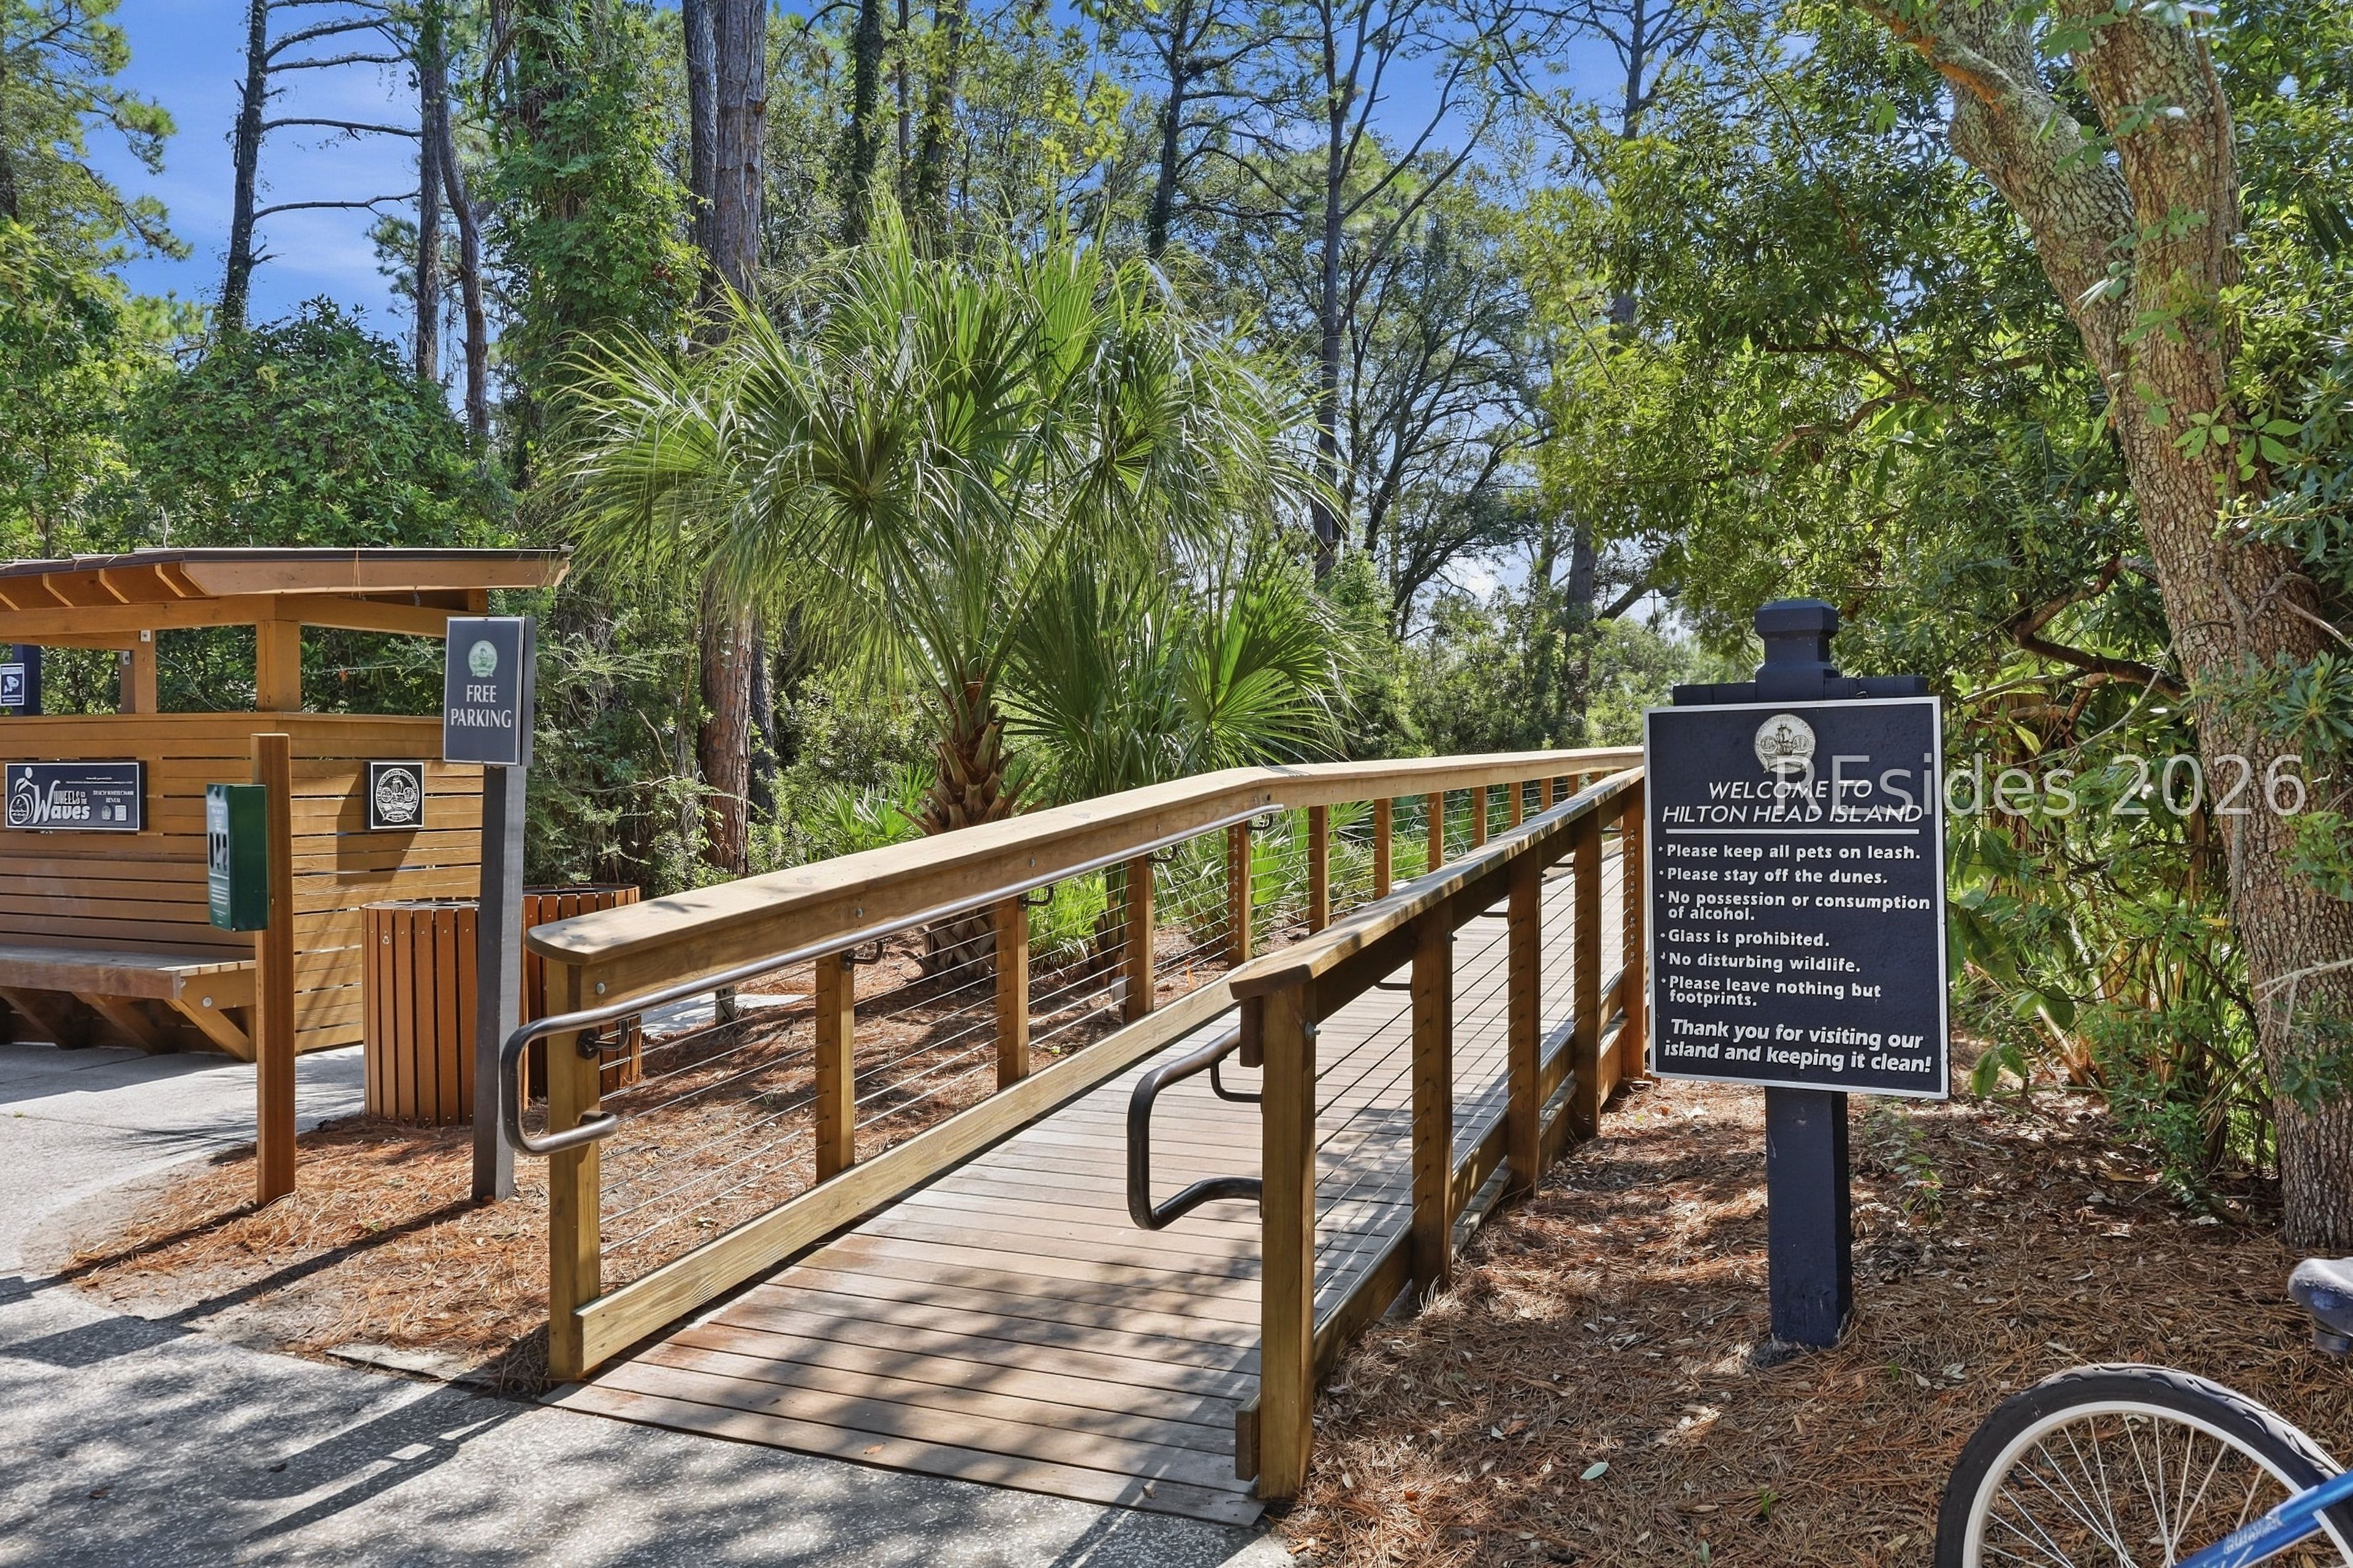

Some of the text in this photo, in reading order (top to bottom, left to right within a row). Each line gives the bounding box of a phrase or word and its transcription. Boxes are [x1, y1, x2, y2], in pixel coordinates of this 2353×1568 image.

[466, 684, 497, 703] FREE
[450, 708, 512, 728] PARKING
[53, 790, 80, 805] WHEELS
[1708, 779, 1873, 800] WELCOME TO
[1662, 804, 1923, 824] HILTON HEAD ISLAND
[1667, 844, 1920, 862] Please keep all pets on leash.
[1667, 867, 1887, 885] Please stay off the dunes.
[1668, 890, 1930, 913] No possession or consumption
[1668, 906, 1755, 920] of alcohol.
[1669, 929, 1830, 948] Glass is prohibited.
[1669, 952, 1860, 973] No disturbing wildlife.
[1669, 975, 1881, 1000] Please leave nothing but
[1670, 990, 1757, 1008] footprints.
[1671, 1018, 1923, 1051] Thank you for visiting our
[1664, 1039, 1932, 1073] island and keeping it clean!
